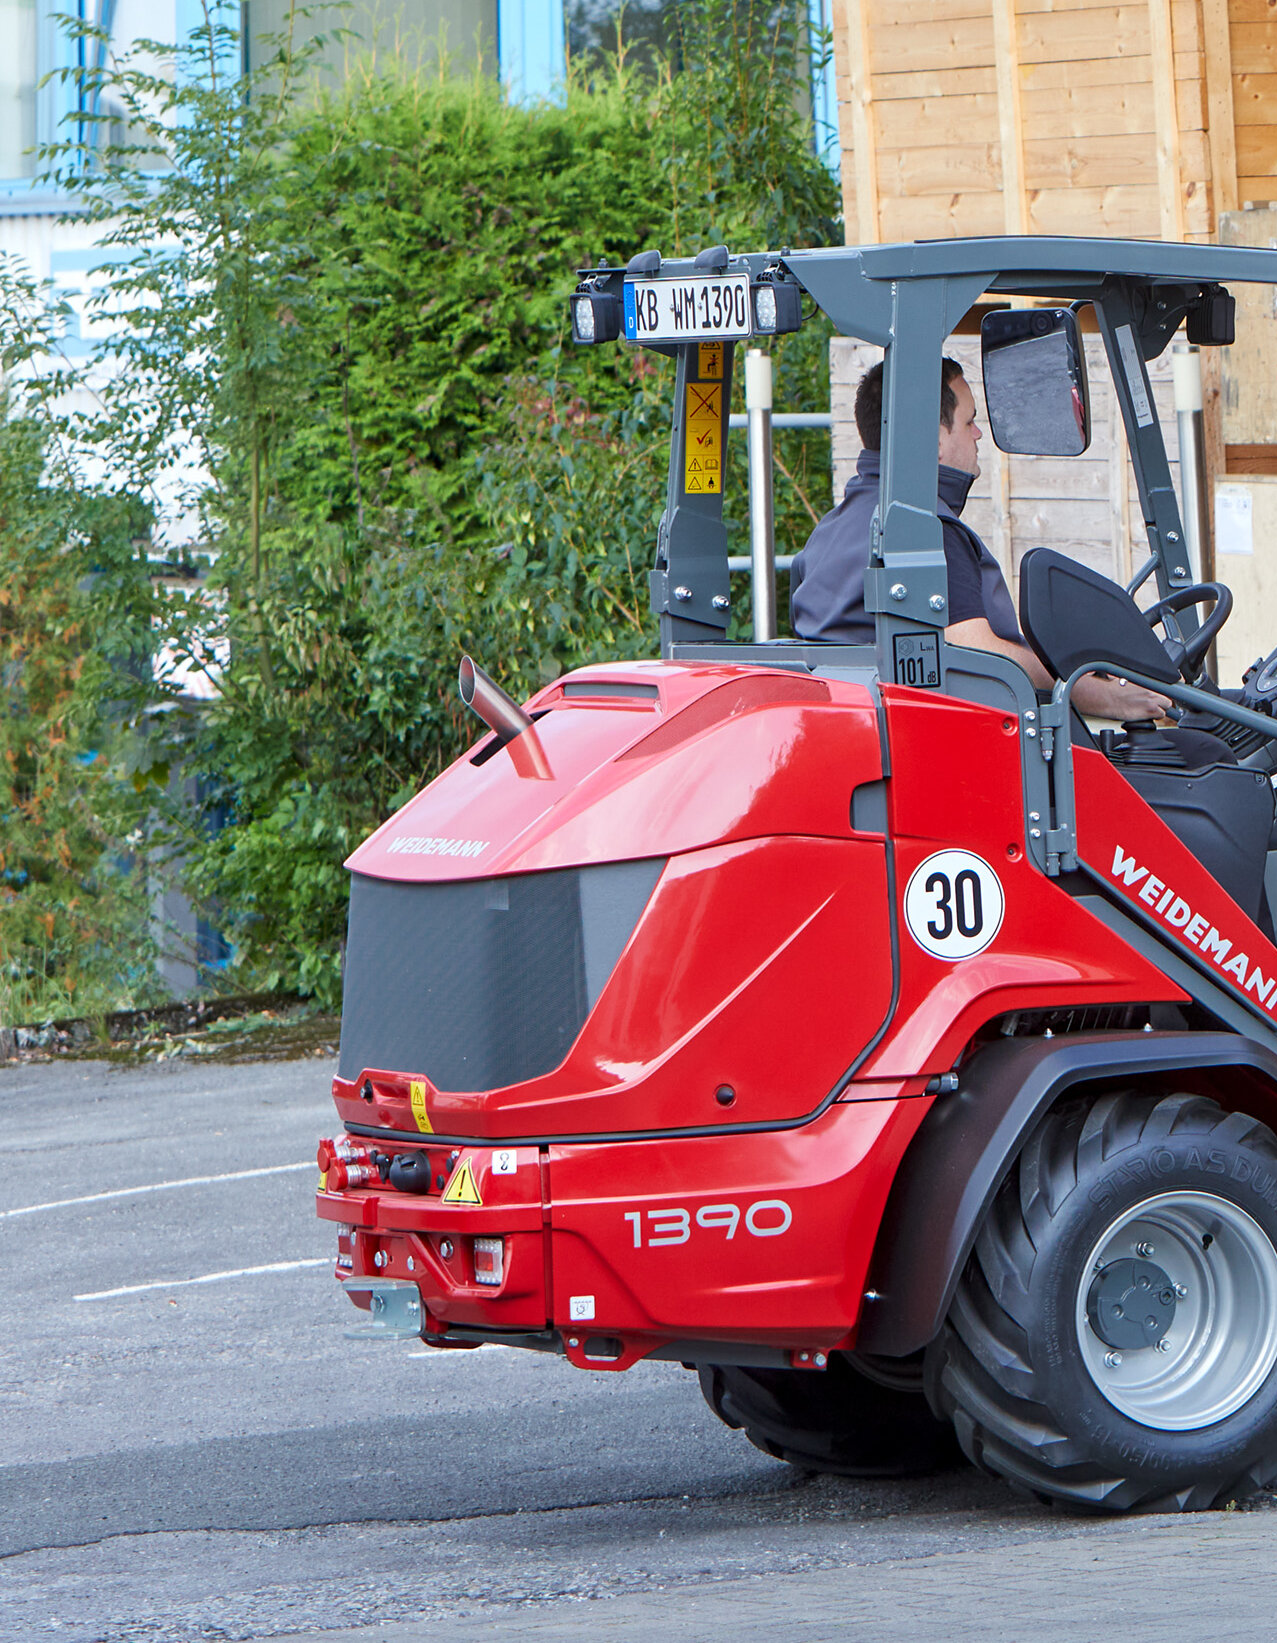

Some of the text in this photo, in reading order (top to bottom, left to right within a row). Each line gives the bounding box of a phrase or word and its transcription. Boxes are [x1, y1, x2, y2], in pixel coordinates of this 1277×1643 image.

[629, 284, 745, 331] D KB WM 1390
[899, 657, 936, 684] 101 dB
[386, 837, 490, 857] WEIDEMANN
[925, 869, 983, 940] 30
[1183, 1146, 1226, 1175] AS
[624, 1199, 793, 1248] 1390
